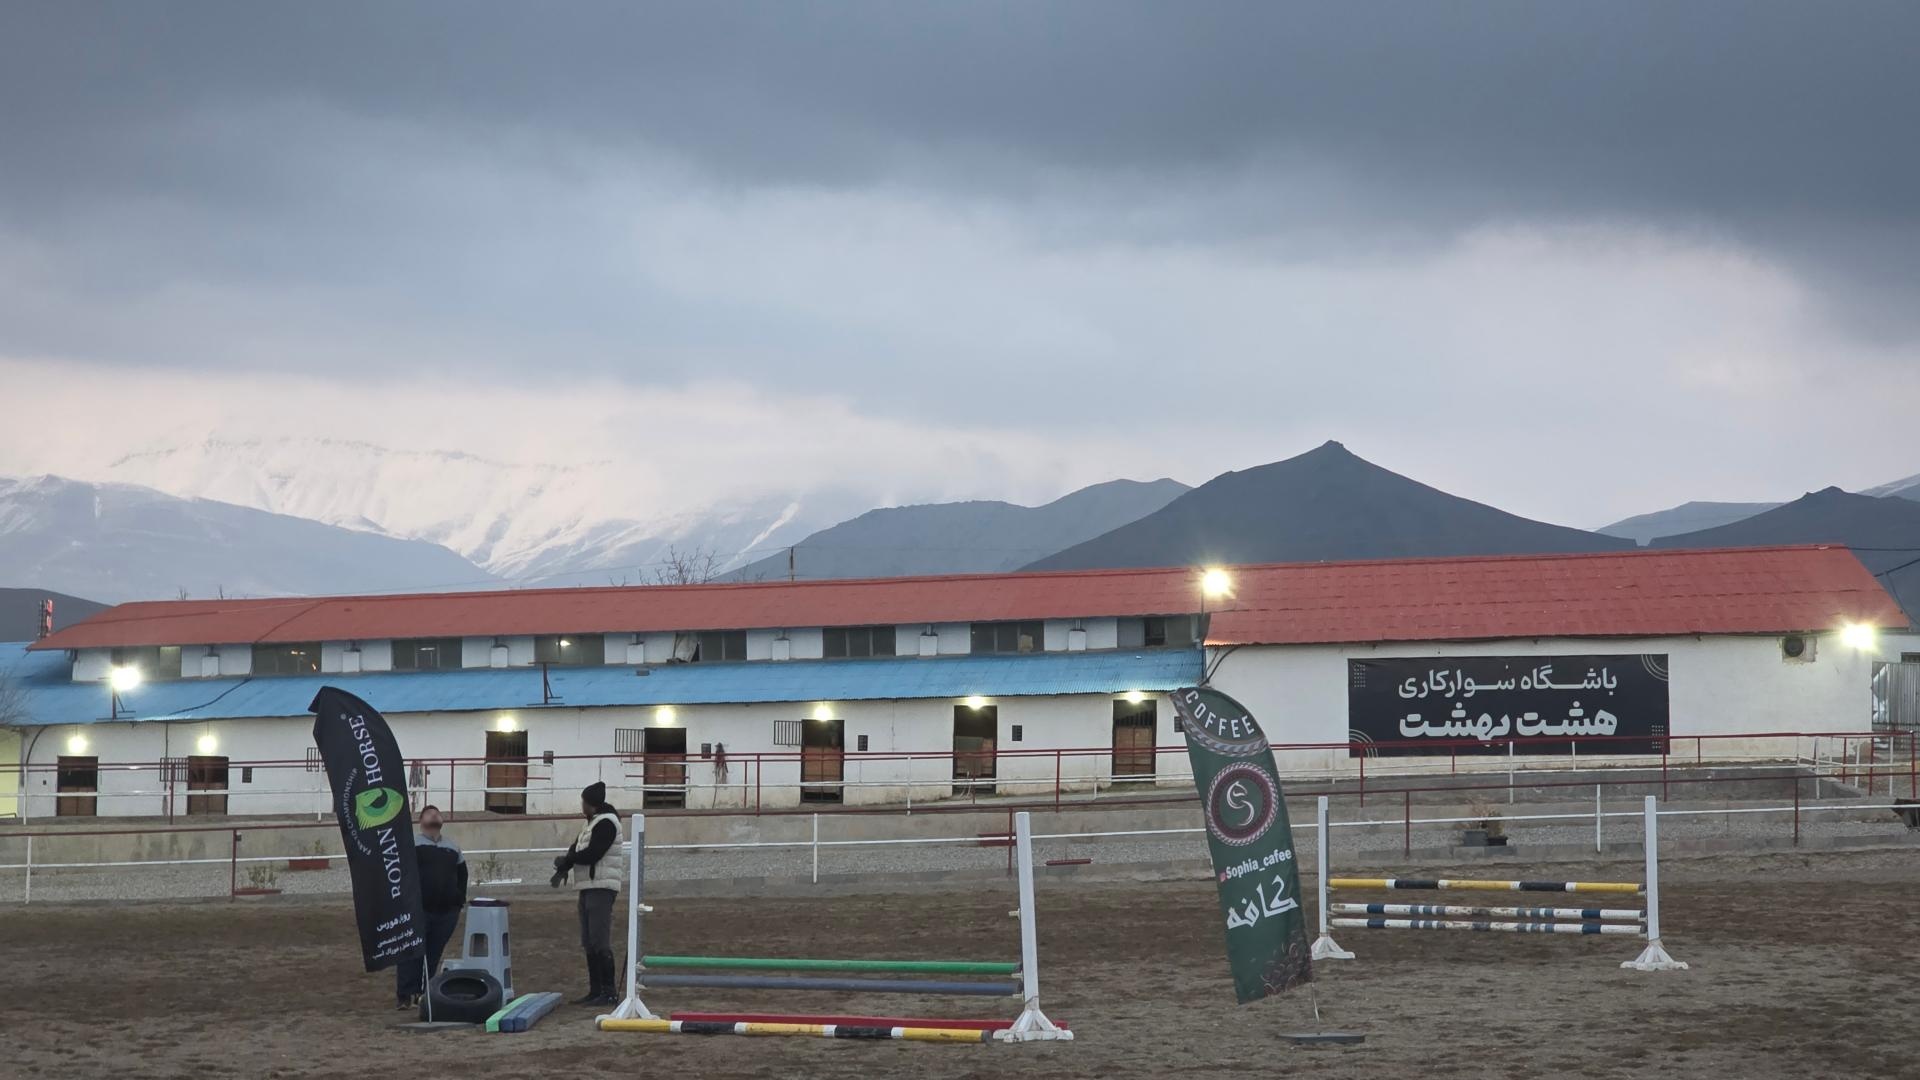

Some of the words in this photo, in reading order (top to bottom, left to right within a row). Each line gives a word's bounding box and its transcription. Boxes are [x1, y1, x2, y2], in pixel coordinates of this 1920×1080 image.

[1398, 669, 1516, 699] سوارکاری
[1520, 665, 1618, 696] باشگاه
[1185, 690, 1255, 738] COFFEE
[1399, 702, 1511, 747] بهشت
[1516, 701, 1618, 737] هشت
[349, 714, 383, 786] HORSE
[377, 827, 402, 899] ROYAN
[1225, 848, 1292, 880] Sophia_cafee
[1227, 874, 1299, 930] کافه
